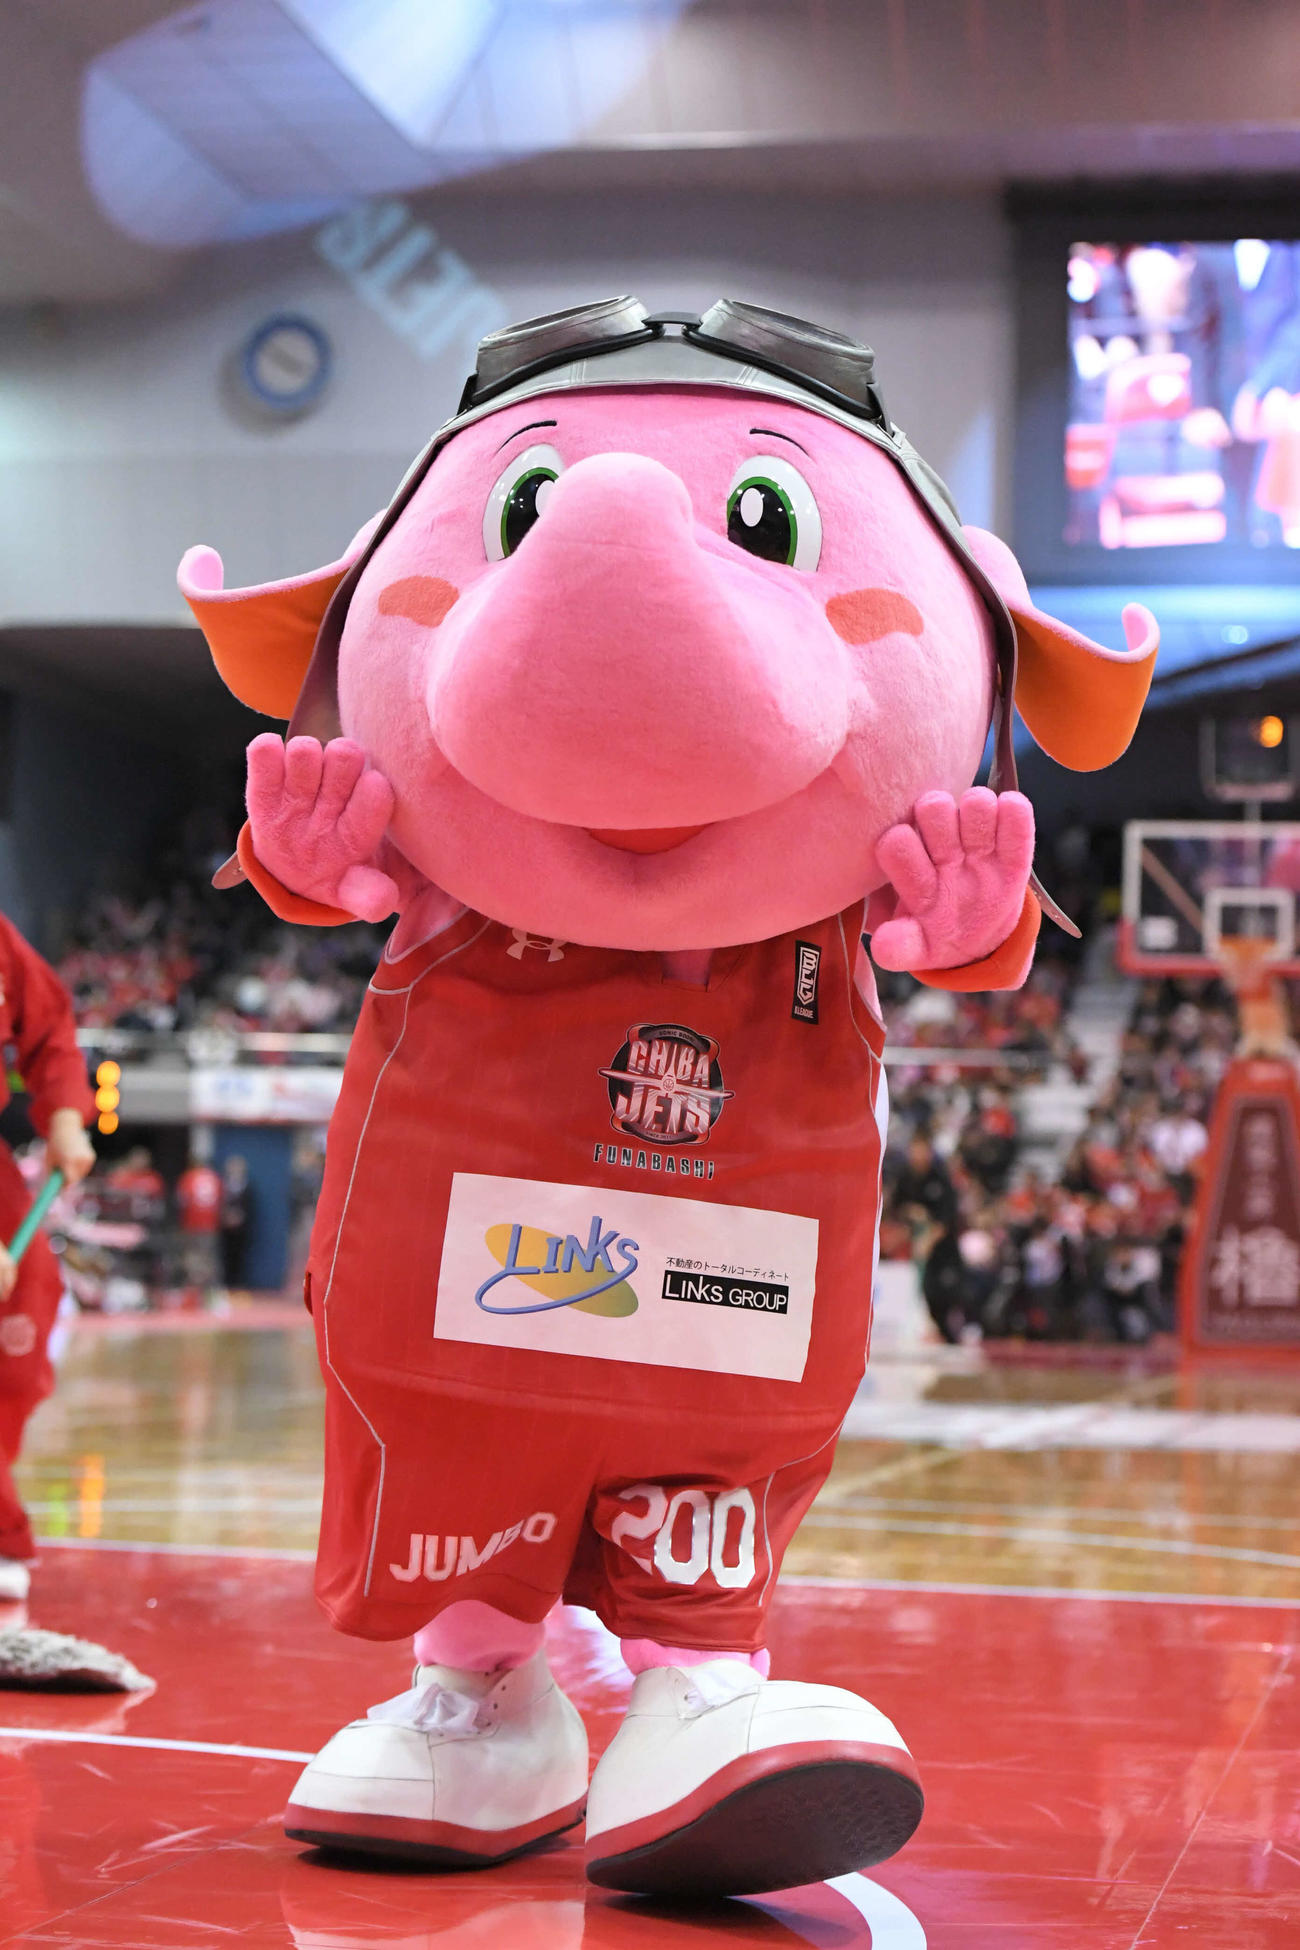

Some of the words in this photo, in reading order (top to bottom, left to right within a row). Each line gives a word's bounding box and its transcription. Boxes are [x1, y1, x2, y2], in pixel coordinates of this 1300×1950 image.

[627, 1039, 711, 1088] CHIBA
[614, 1082, 712, 1135] JETS
[593, 1142, 715, 1181] FUNABASHI
[665, 1256, 789, 1282] 不動産のトータルコーディネート
[728, 1287, 787, 1311] GROUP
[388, 1511, 557, 1584] JUMBO
[610, 1483, 756, 1589] 200
